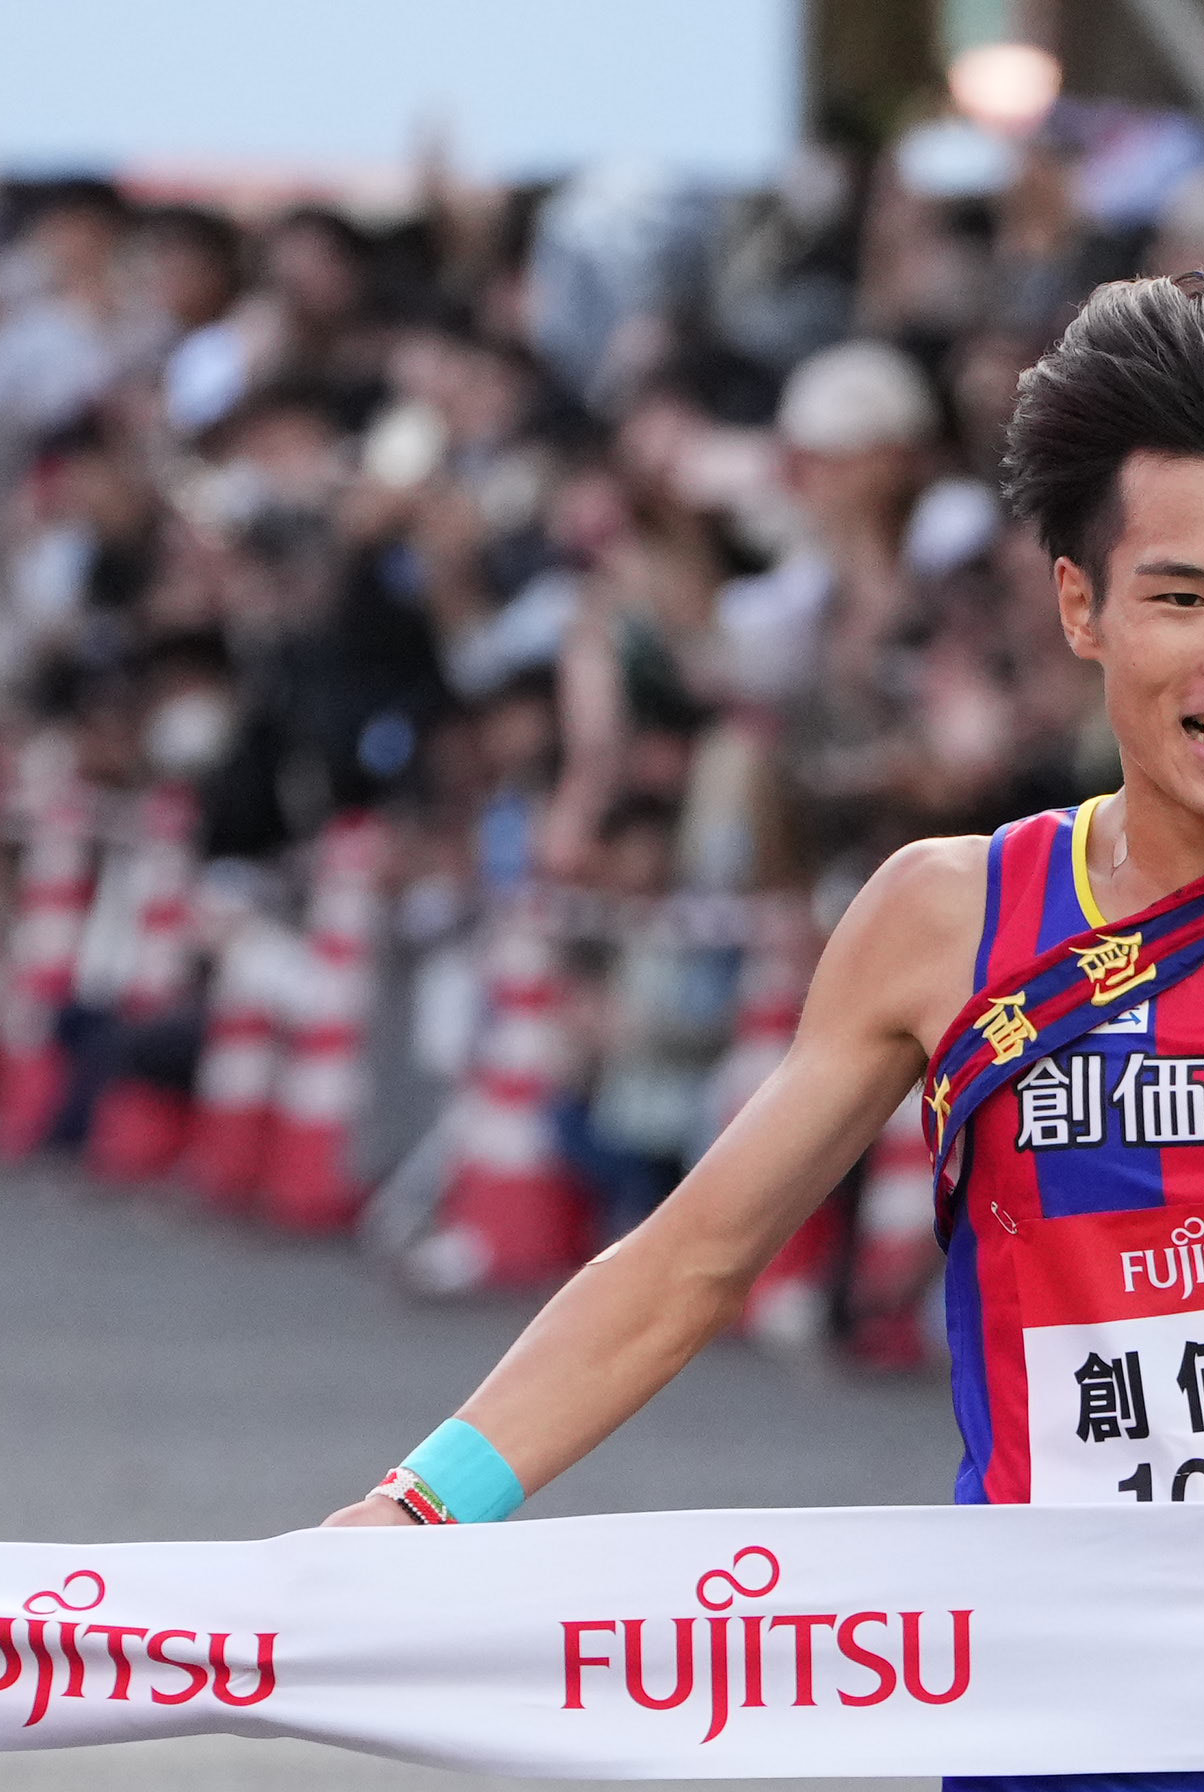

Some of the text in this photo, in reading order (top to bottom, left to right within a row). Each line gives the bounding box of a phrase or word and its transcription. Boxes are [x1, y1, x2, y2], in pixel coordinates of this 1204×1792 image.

[924, 931, 1158, 1164] 創価大
[561, 1609, 975, 1745] FUJITSU
